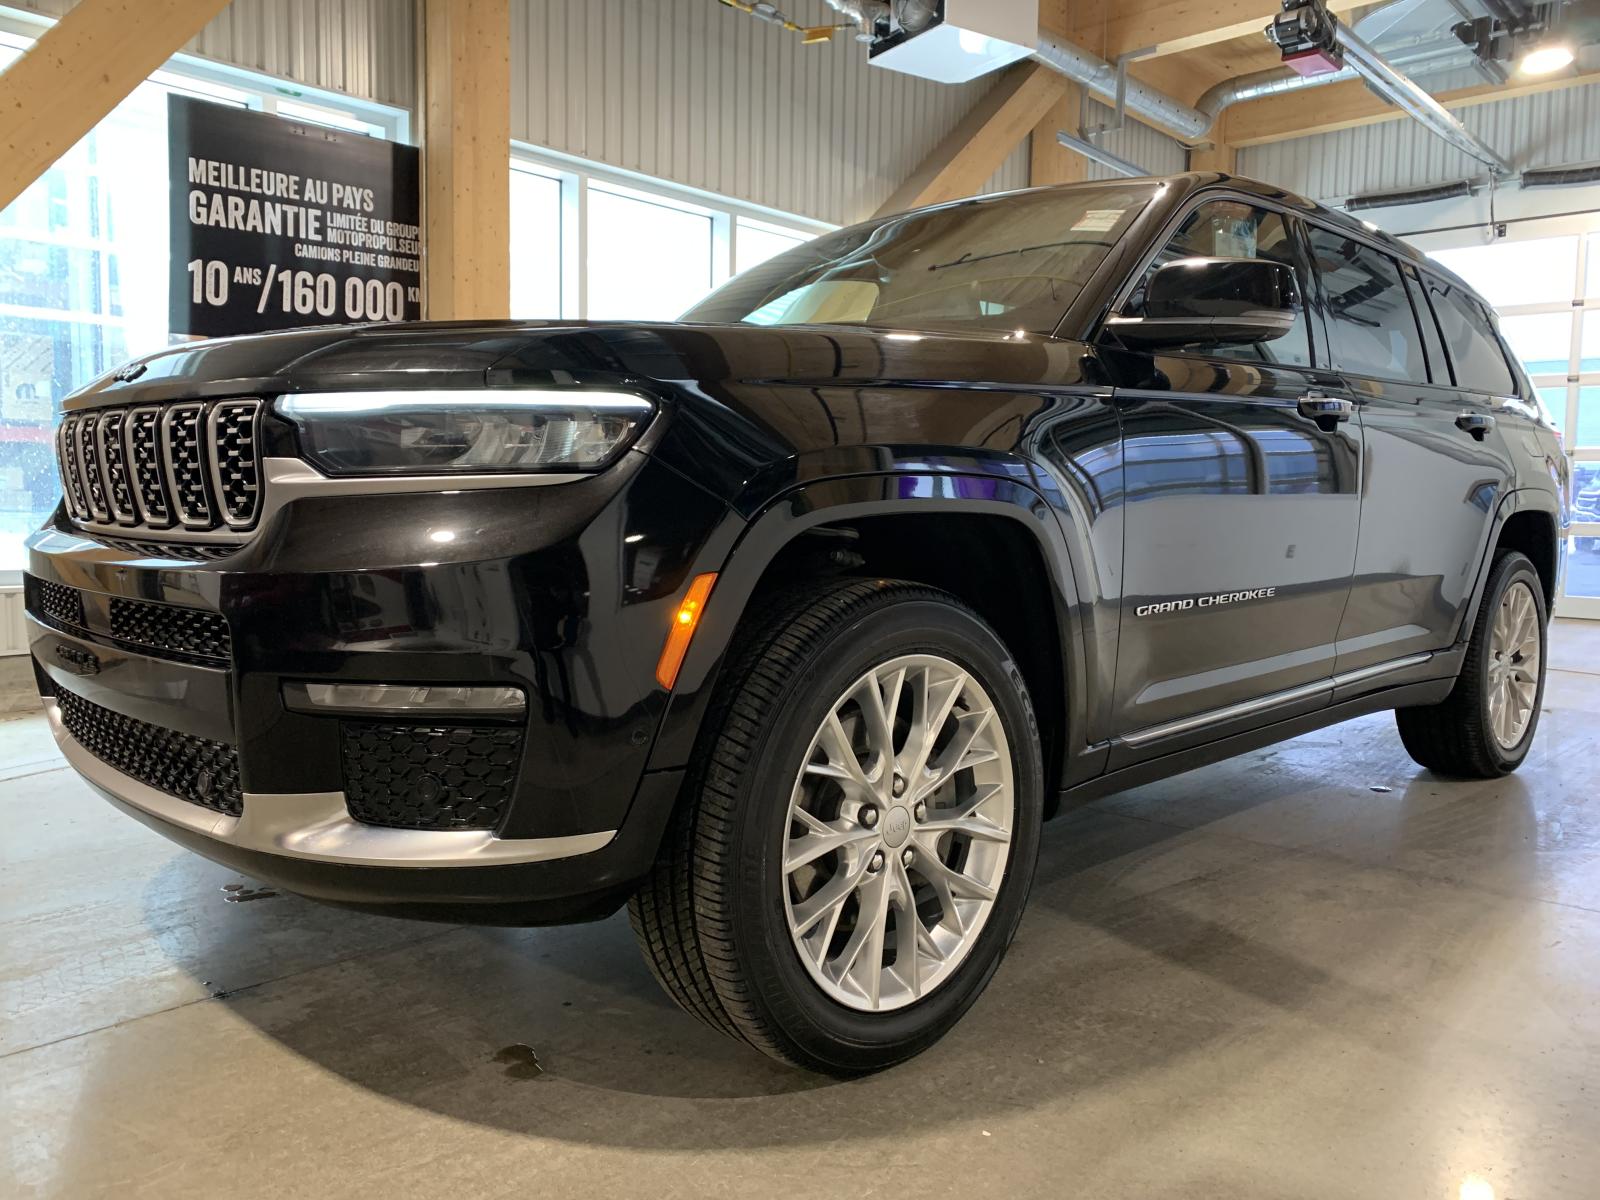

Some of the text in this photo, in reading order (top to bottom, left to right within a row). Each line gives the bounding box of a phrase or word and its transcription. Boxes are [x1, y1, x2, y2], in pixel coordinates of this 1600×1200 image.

[188, 157, 374, 212] MEILLEURE AU PAYS
[189, 190, 322, 241] GARANTIE
[327, 212, 420, 239] LIMITÉE DU GROUP
[327, 227, 420, 255] MOTOPROPULSEU
[294, 243, 419, 272] CAMIONS PLEINE GRANDEU
[188, 258, 229, 307] 10
[1135, 587, 1276, 617] GRAND CHEROKEE
